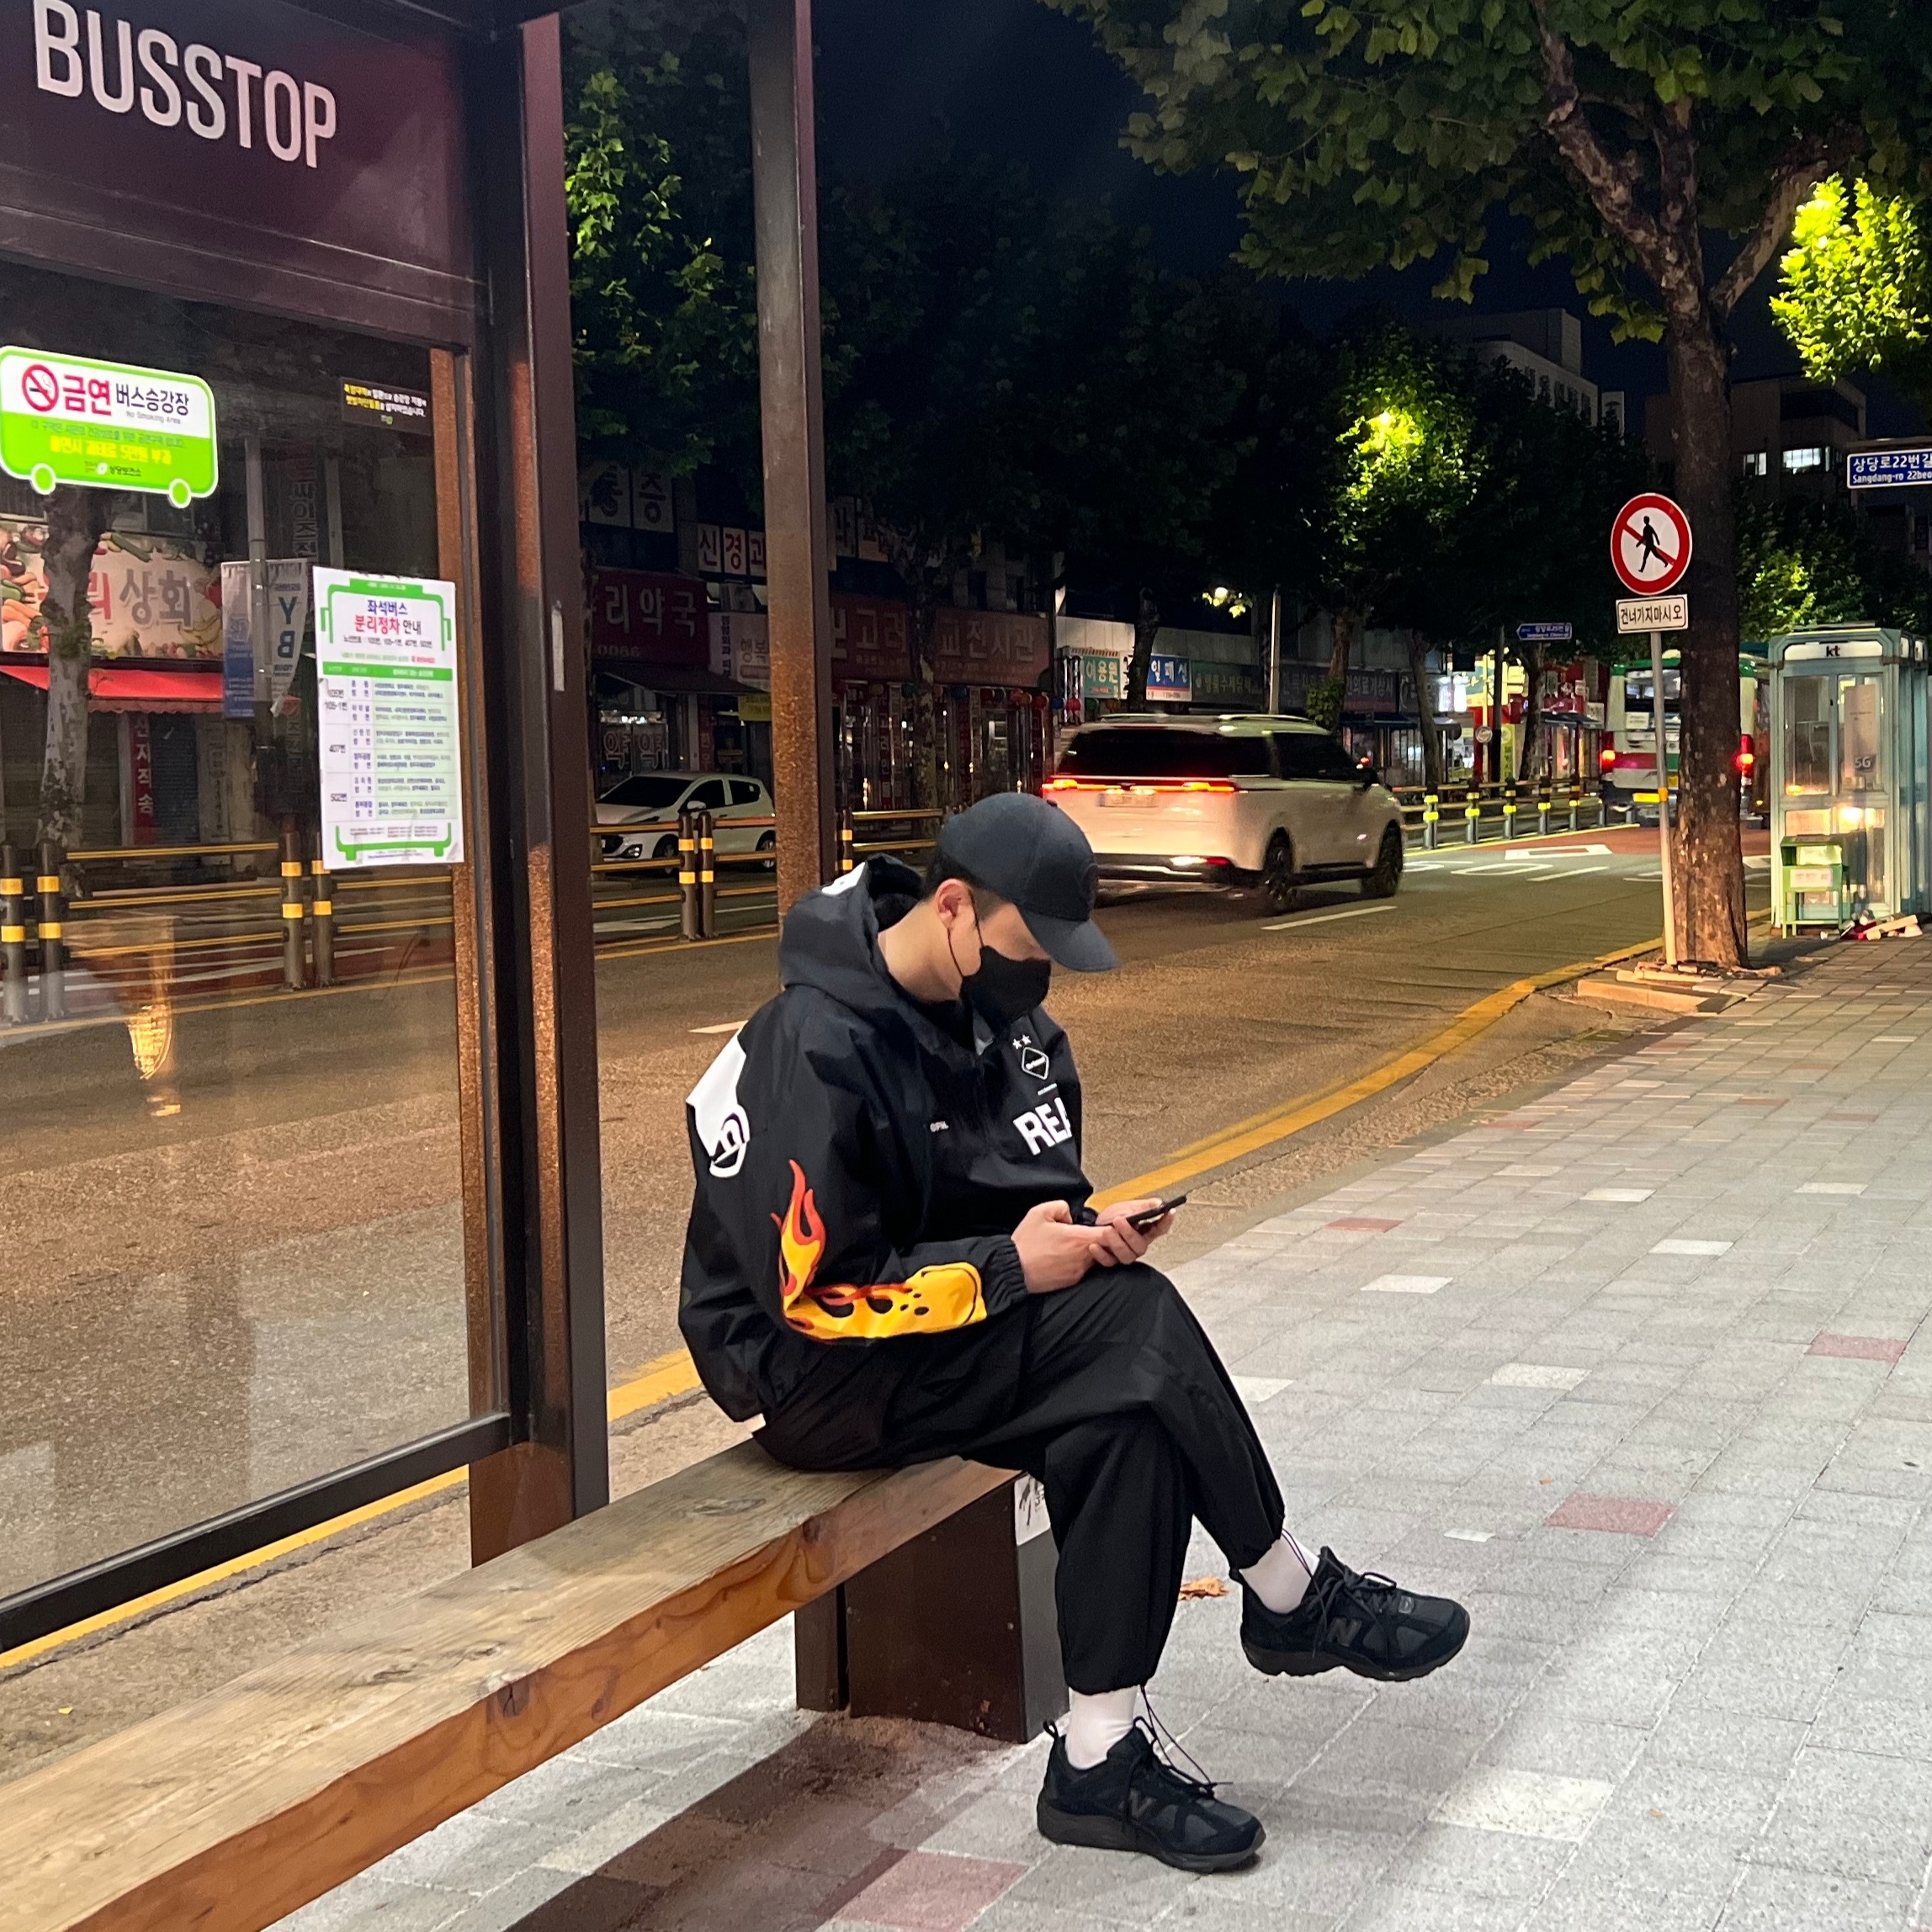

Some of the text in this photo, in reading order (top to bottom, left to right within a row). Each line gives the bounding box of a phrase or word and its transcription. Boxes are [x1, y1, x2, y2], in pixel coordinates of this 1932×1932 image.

[33, 0, 337, 168] BUSSTOP
[62, 374, 189, 417] 금연 버스승강장
[1853, 454, 1932, 473] 상당로22번길
[1853, 473, 1904, 485] Sangdang-ro
[119, 568, 192, 628] 상회
[367, 599, 407, 617] 좌석버스
[592, 584, 697, 638] 리약국
[354, 615, 422, 635] 분리정차 안내
[1826, 645, 1840, 657] kt
[1085, 660, 1118, 683] 이용원
[1855, 757, 1871, 769] 5G
